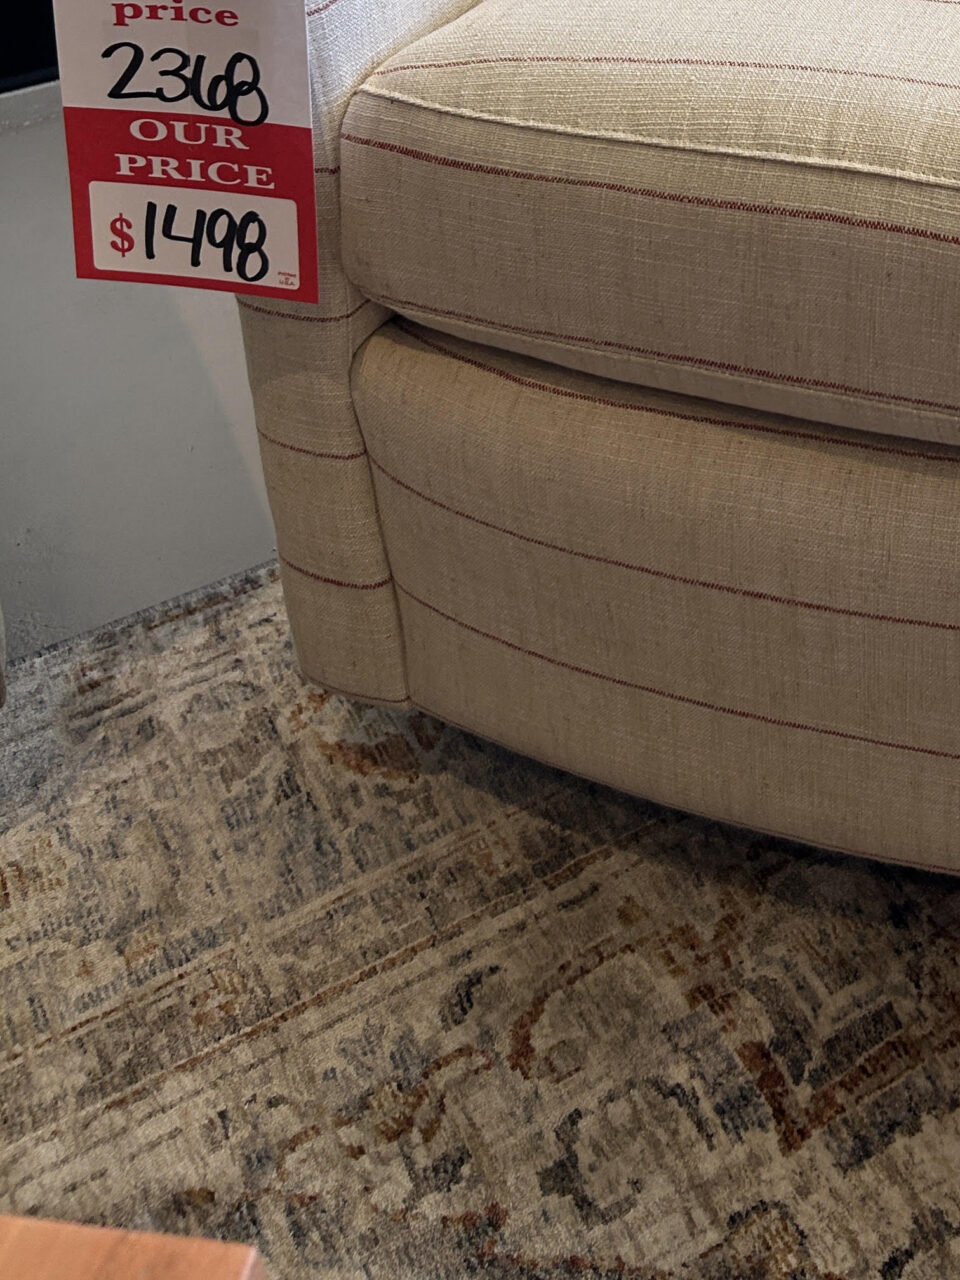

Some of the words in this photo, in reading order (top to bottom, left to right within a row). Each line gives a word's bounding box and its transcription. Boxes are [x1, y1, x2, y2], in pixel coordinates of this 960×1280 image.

[101, 41, 269, 126] 2368
[129, 118, 250, 150] OUR
[114, 153, 275, 189] PRICE
